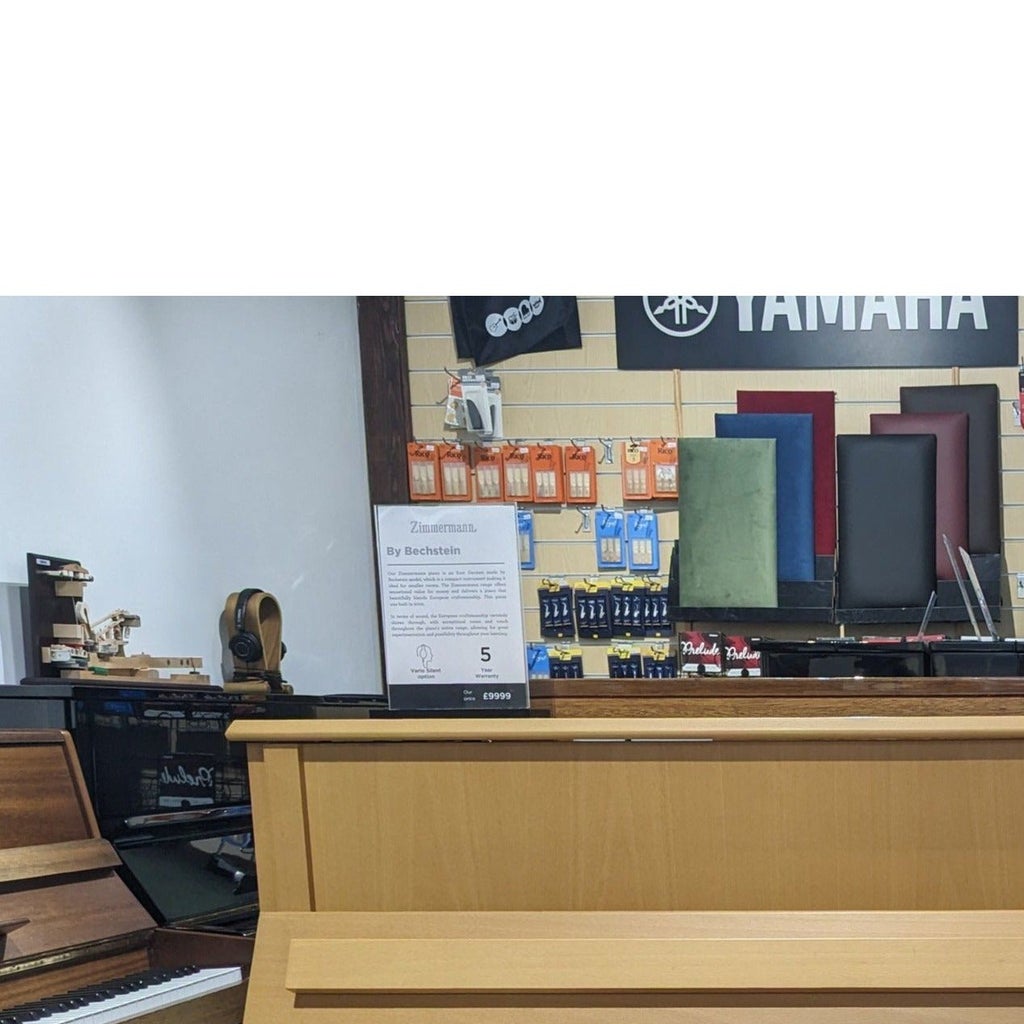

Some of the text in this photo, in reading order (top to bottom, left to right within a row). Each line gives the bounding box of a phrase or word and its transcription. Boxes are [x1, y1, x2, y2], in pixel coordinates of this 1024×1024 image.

[736, 296, 988, 331] YAMAHA
[386, 546, 461, 557] By Bechstein
[480, 646, 492, 662] 5
[681, 641, 720, 656] Prelude
[482, 692, 512, 700] £9999
